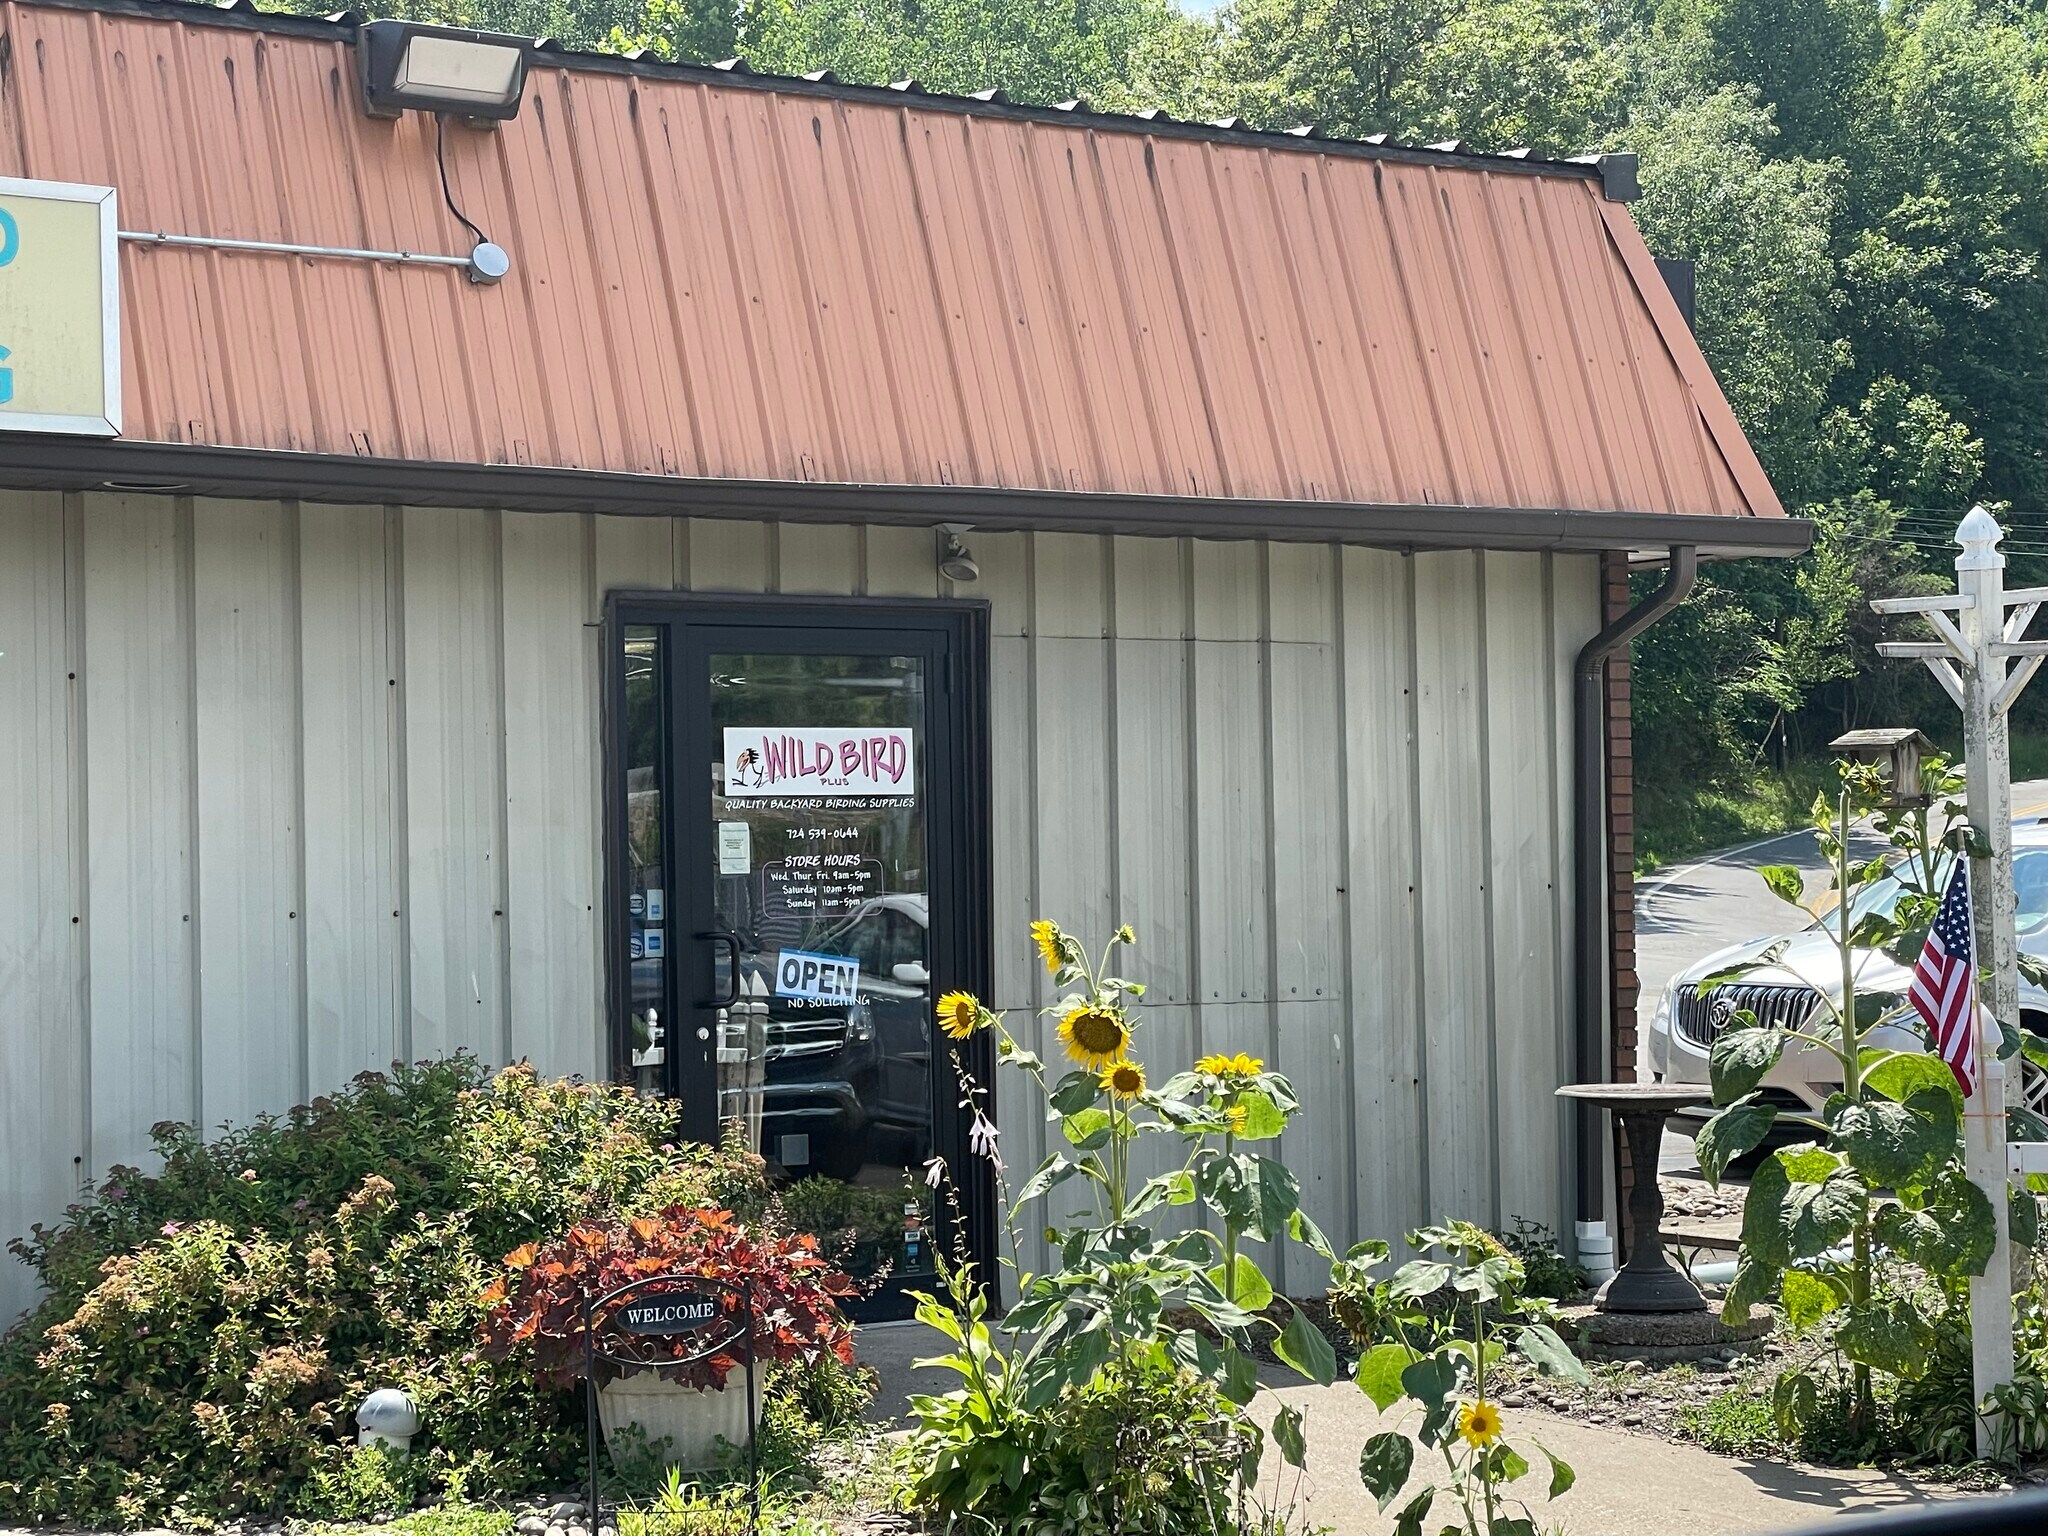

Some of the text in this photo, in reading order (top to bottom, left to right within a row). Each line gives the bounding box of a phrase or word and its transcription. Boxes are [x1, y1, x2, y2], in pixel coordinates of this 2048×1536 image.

[763, 734, 906, 784] WILD BIRD
[820, 778, 849, 786] PLUS
[725, 797, 915, 811] QUALITY BACKYARD BIRDING SUPPLIES
[786, 828, 859, 840] 724 539-0644
[784, 854, 861, 867] STORE HOURS
[770, 870, 871, 881] Wed. Thur. Fri. 9am-5pm
[782, 884, 864, 896] Saturday 10am-5pm
[786, 897, 860, 909] Sunday 11am-5pm
[782, 958, 854, 997] OPEN
[788, 994, 870, 1008] NO SOLICITING
[627, 1302, 714, 1325] WELCOME
